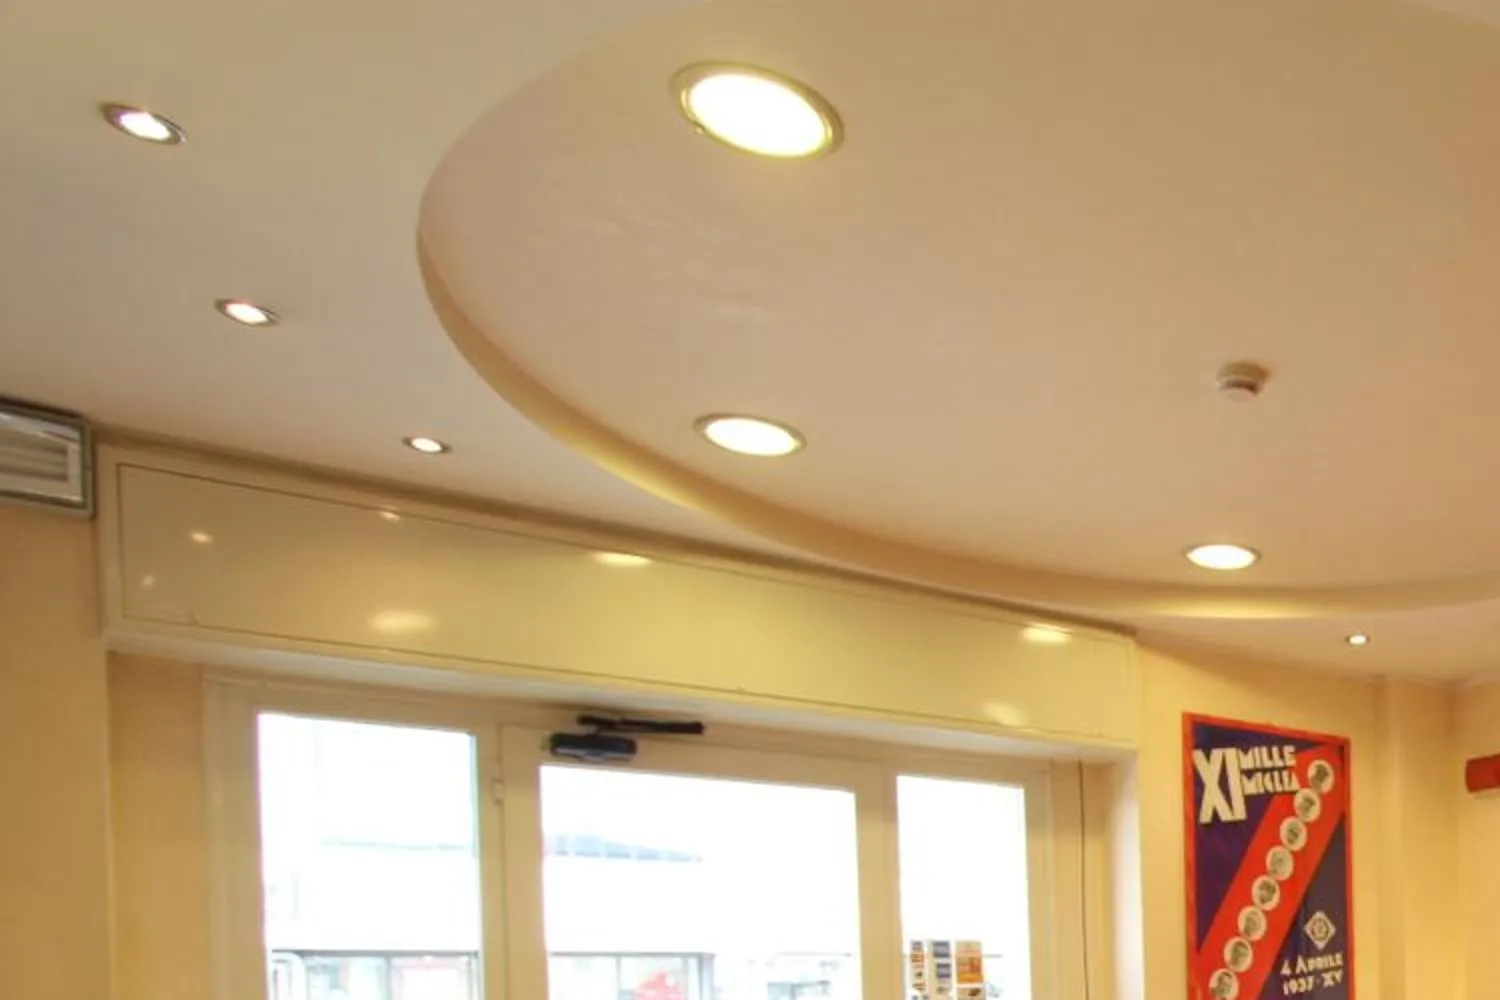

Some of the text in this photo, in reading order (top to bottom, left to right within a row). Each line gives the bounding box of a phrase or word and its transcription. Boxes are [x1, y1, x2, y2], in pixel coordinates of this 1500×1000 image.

[1192, 745, 1296, 823] XI MILLE
[1242, 770, 1300, 795] MIGLIA
